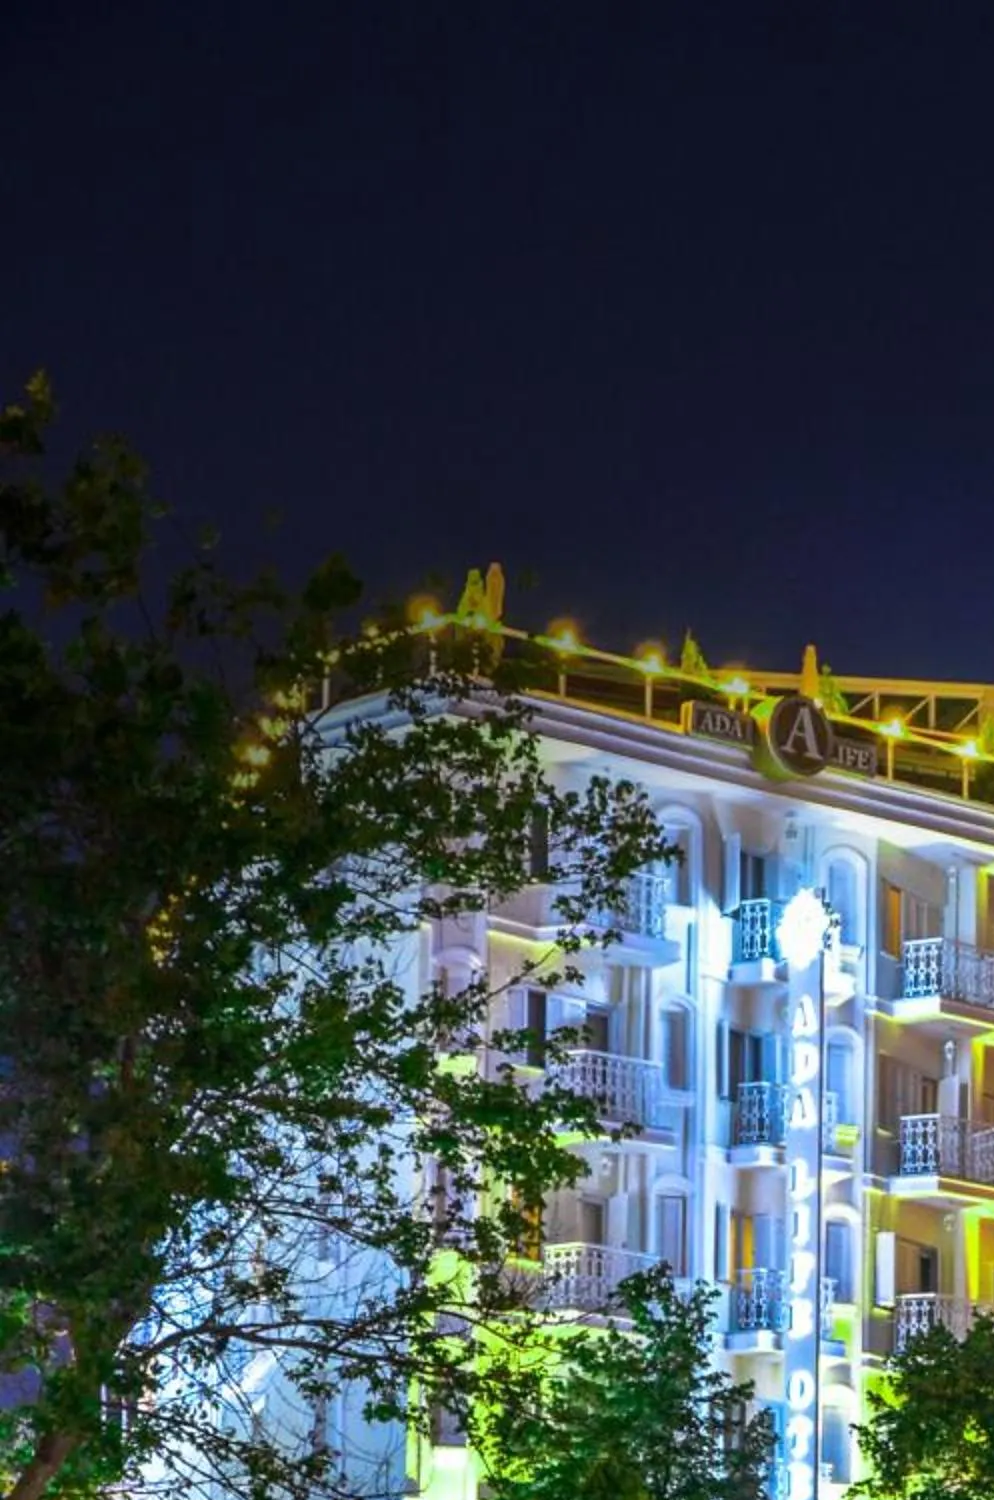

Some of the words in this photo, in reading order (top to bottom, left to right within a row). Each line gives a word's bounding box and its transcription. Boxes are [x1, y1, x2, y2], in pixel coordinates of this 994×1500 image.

[701, 710, 743, 739] ADA
[780, 707, 823, 760] A
[790, 994, 819, 1130] ADA
